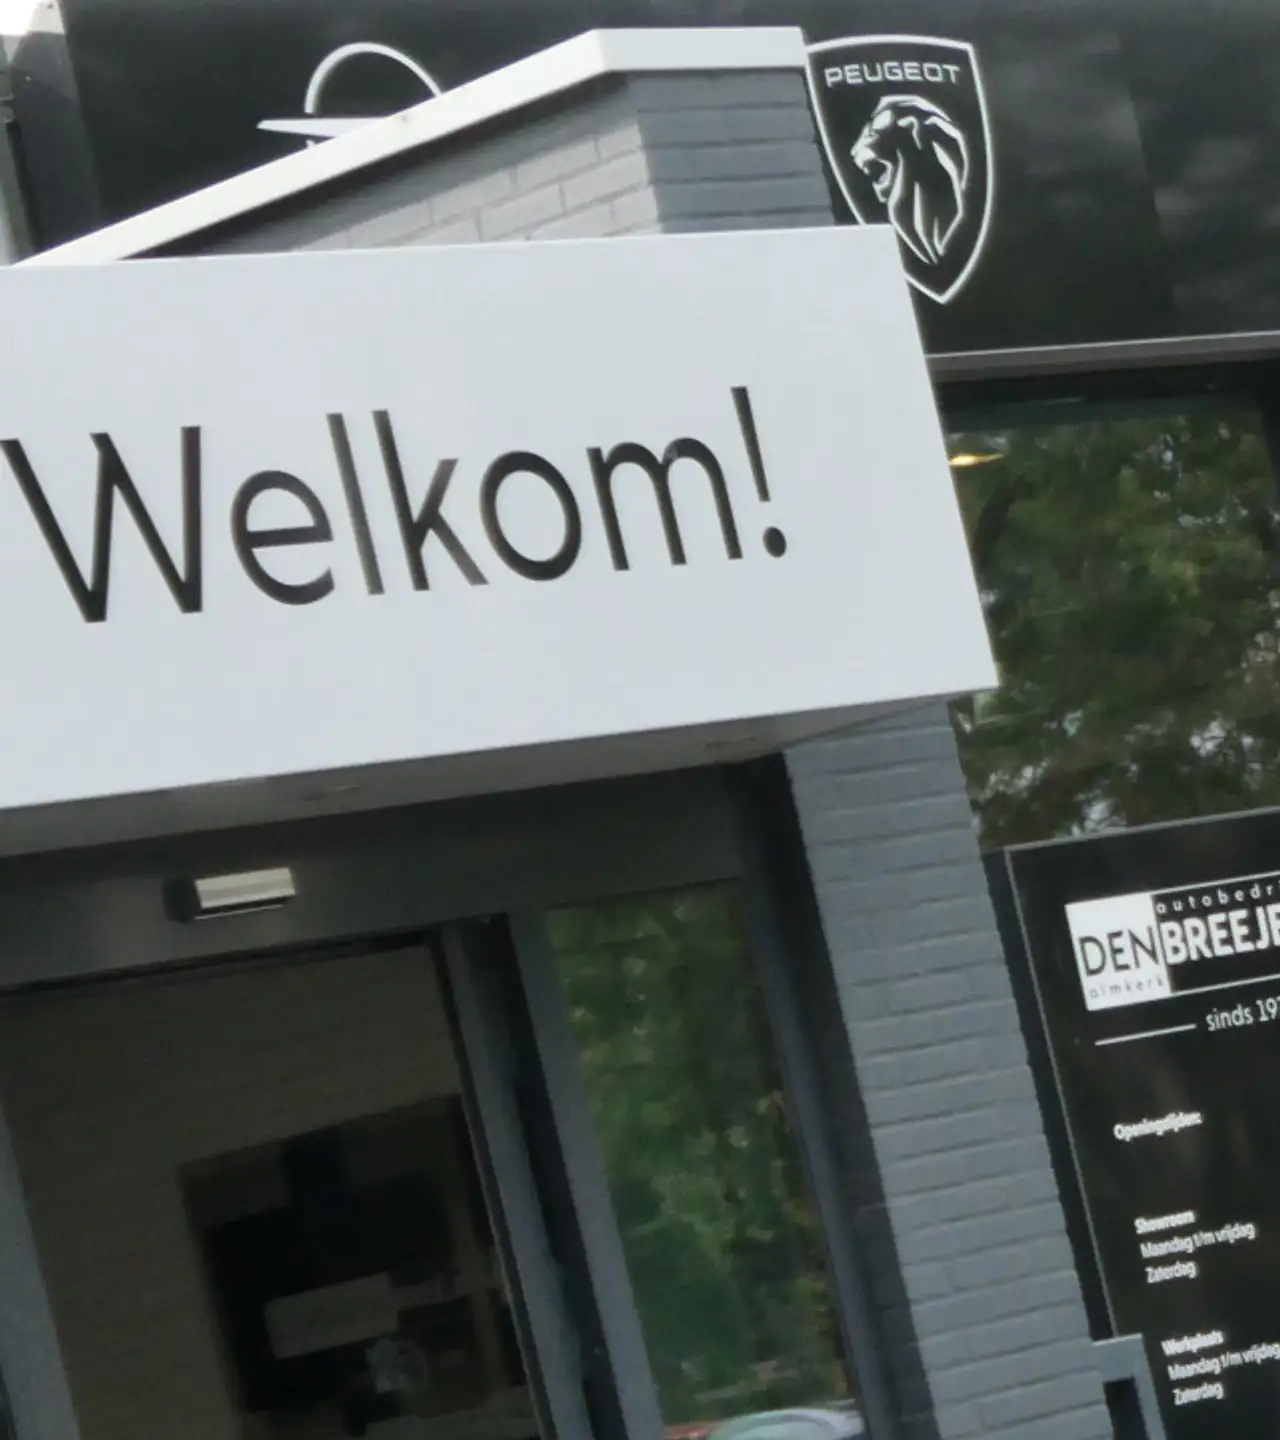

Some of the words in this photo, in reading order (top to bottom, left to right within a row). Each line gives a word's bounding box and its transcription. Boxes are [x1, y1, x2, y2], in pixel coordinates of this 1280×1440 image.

[824, 61, 960, 88] PEUGEOT
[0, 386, 788, 623] Welkom!
[1078, 925, 1161, 977] DEN
[1206, 1005, 1254, 1032] sinds
